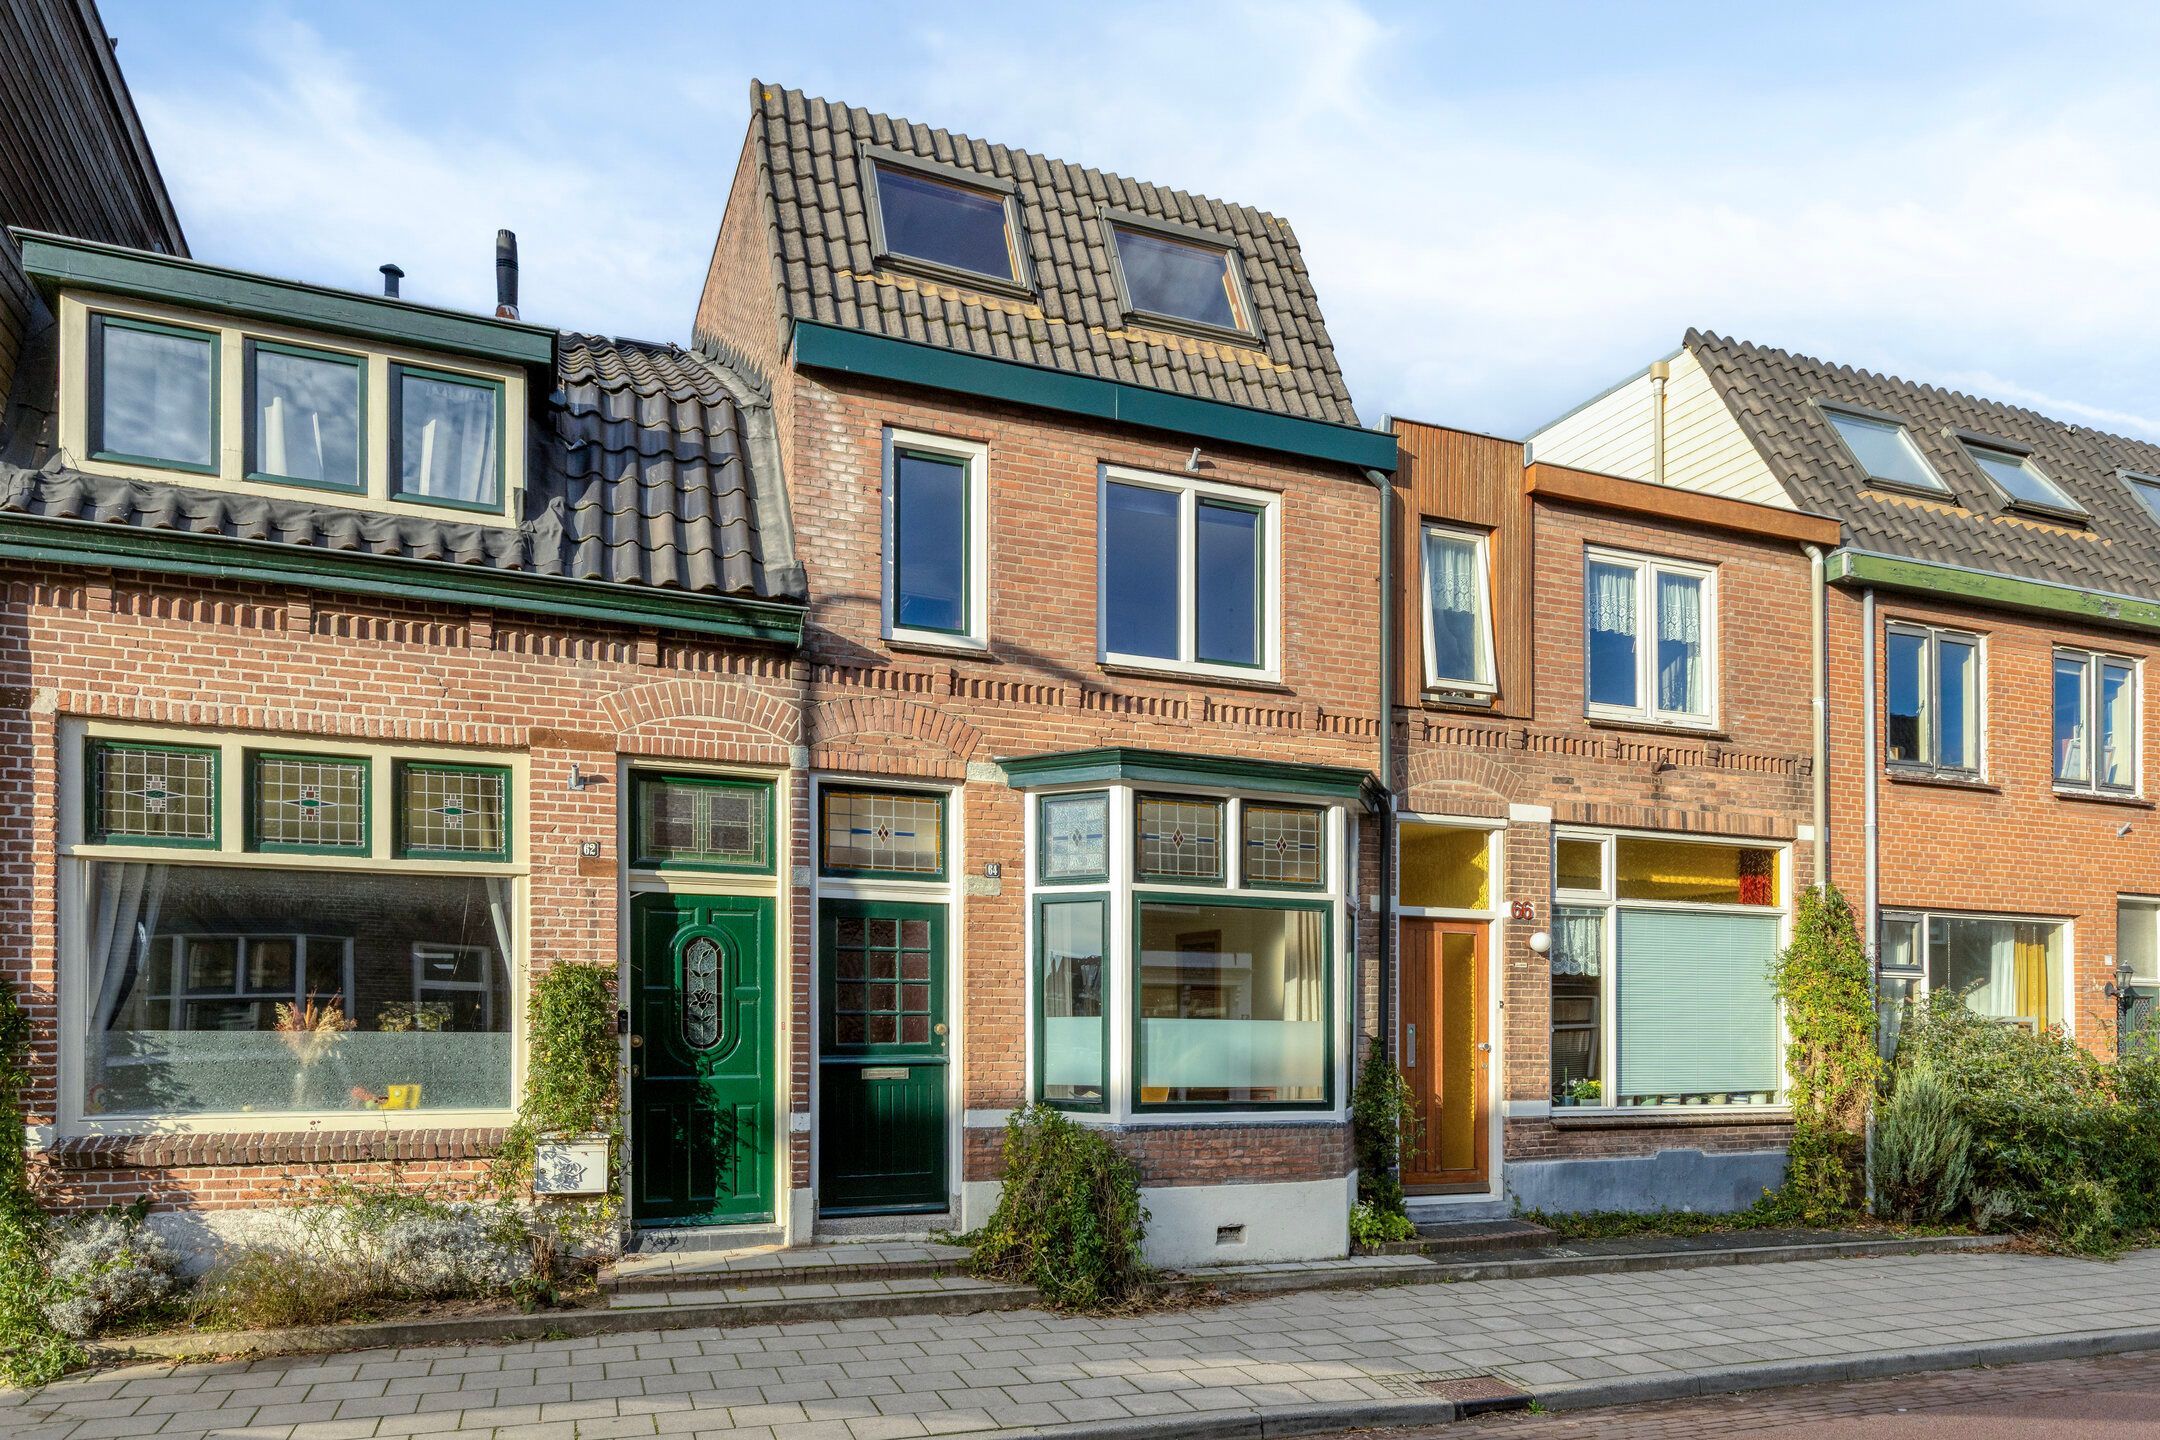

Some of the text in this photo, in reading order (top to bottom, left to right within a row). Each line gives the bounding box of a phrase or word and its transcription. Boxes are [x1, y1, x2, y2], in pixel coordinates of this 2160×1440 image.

[583, 843, 596, 855] 62
[987, 864, 998, 875] 64
[1511, 901, 1534, 920] 66
